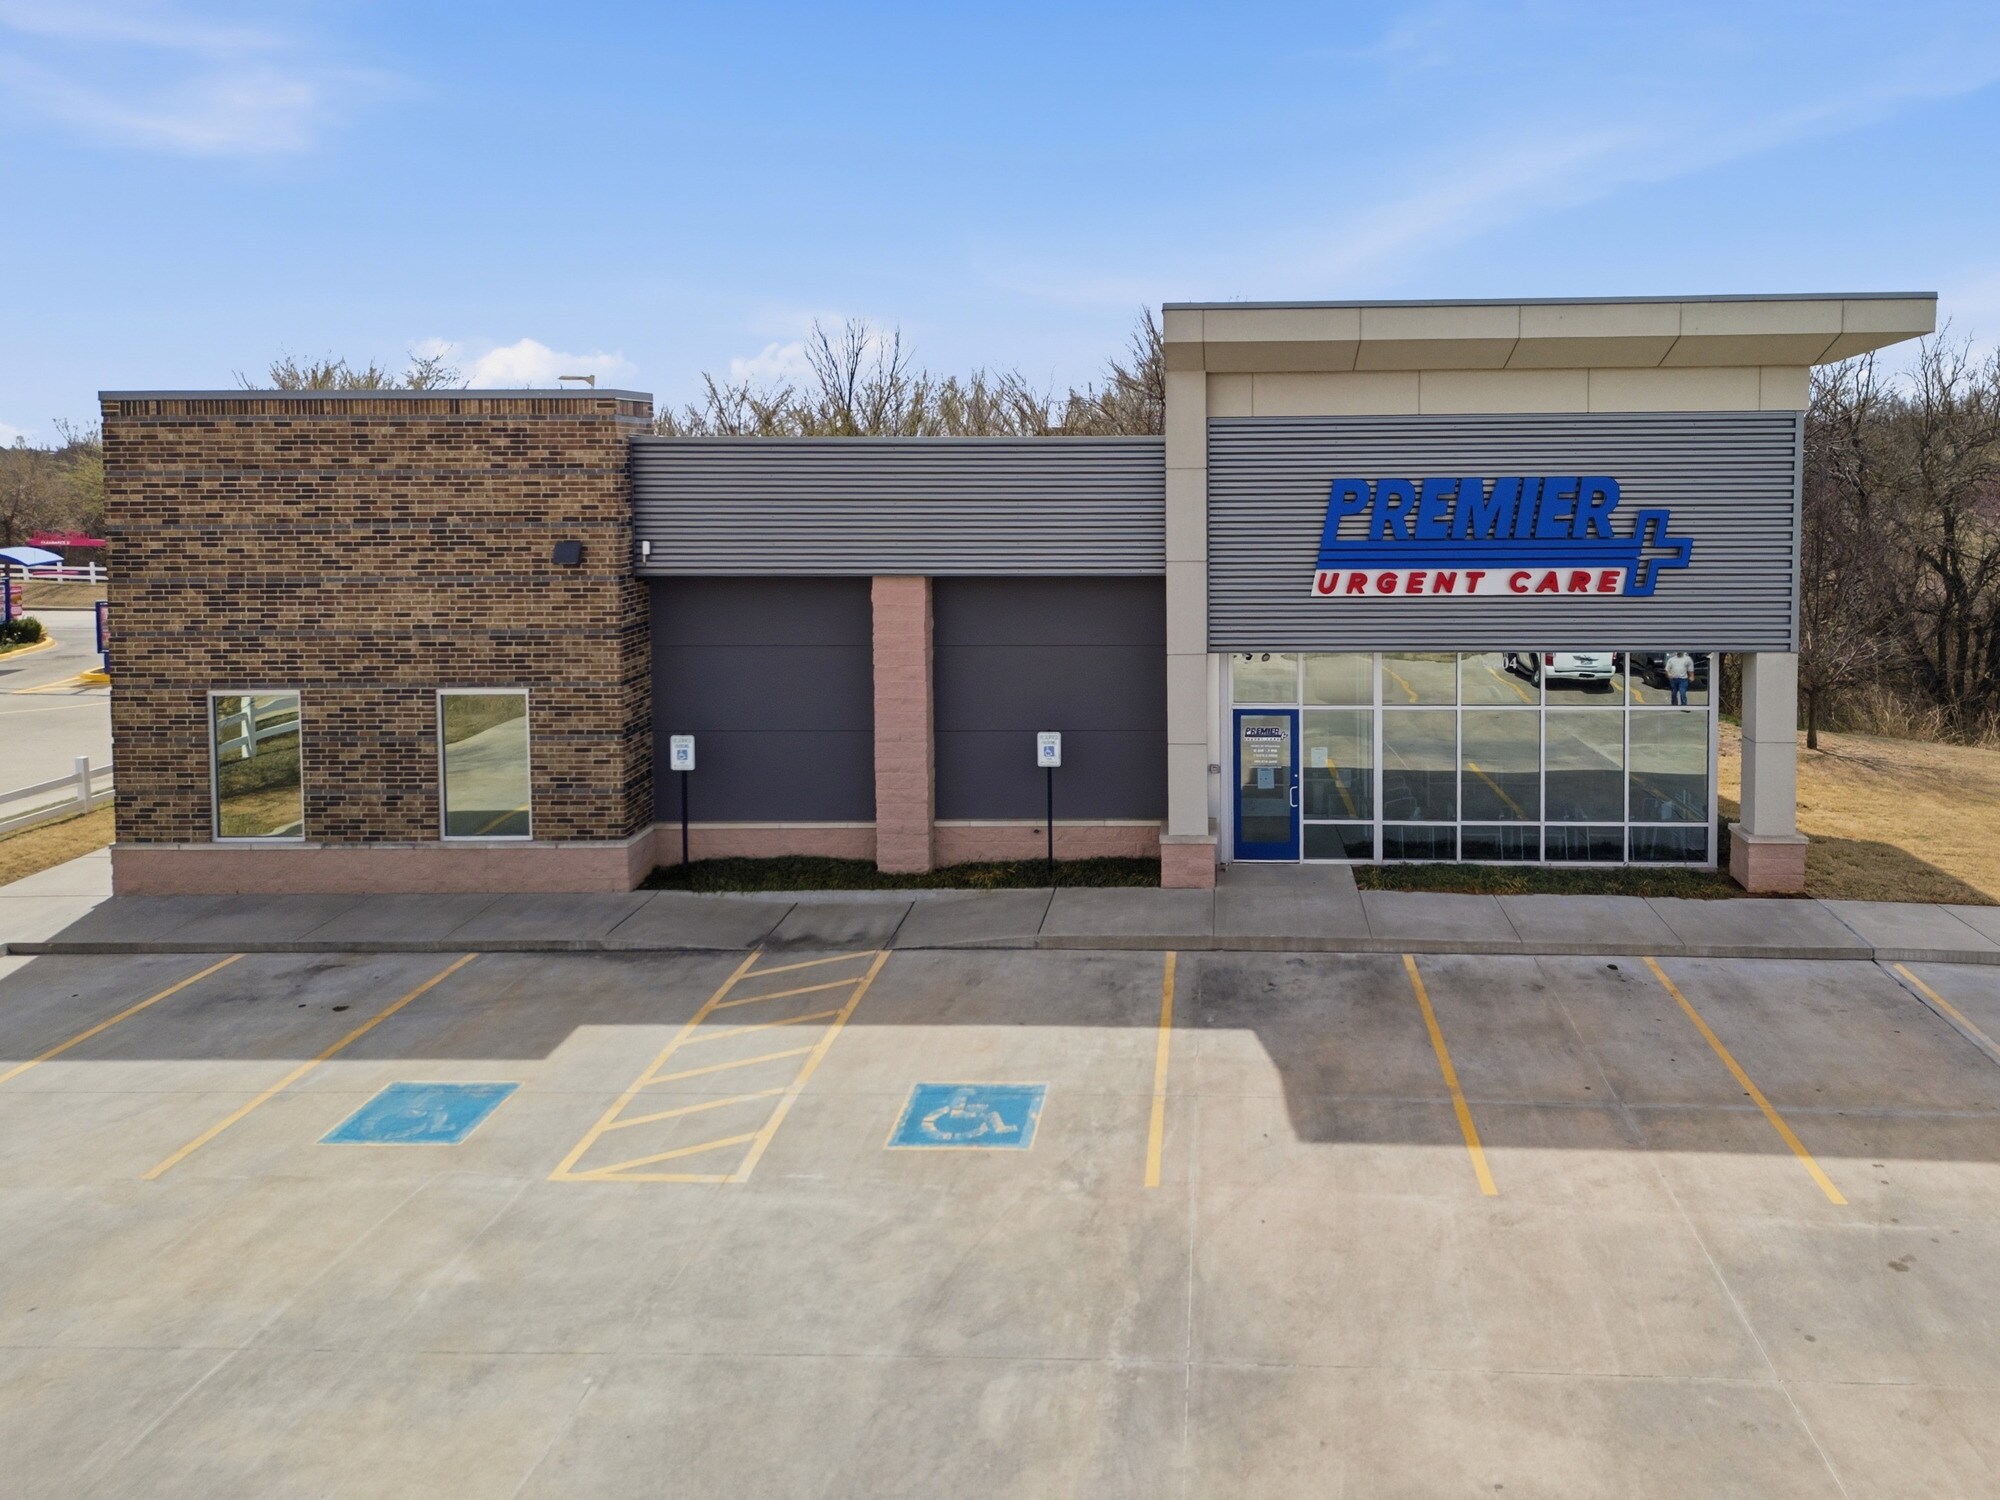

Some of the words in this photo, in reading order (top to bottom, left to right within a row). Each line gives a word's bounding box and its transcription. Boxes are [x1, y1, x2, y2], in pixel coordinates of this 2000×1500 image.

[1319, 476, 1621, 544] PREMIER
[1317, 571, 1486, 595] URGENT
[1508, 570, 1621, 594] CARE
[1245, 727, 1280, 737] PREMIER
